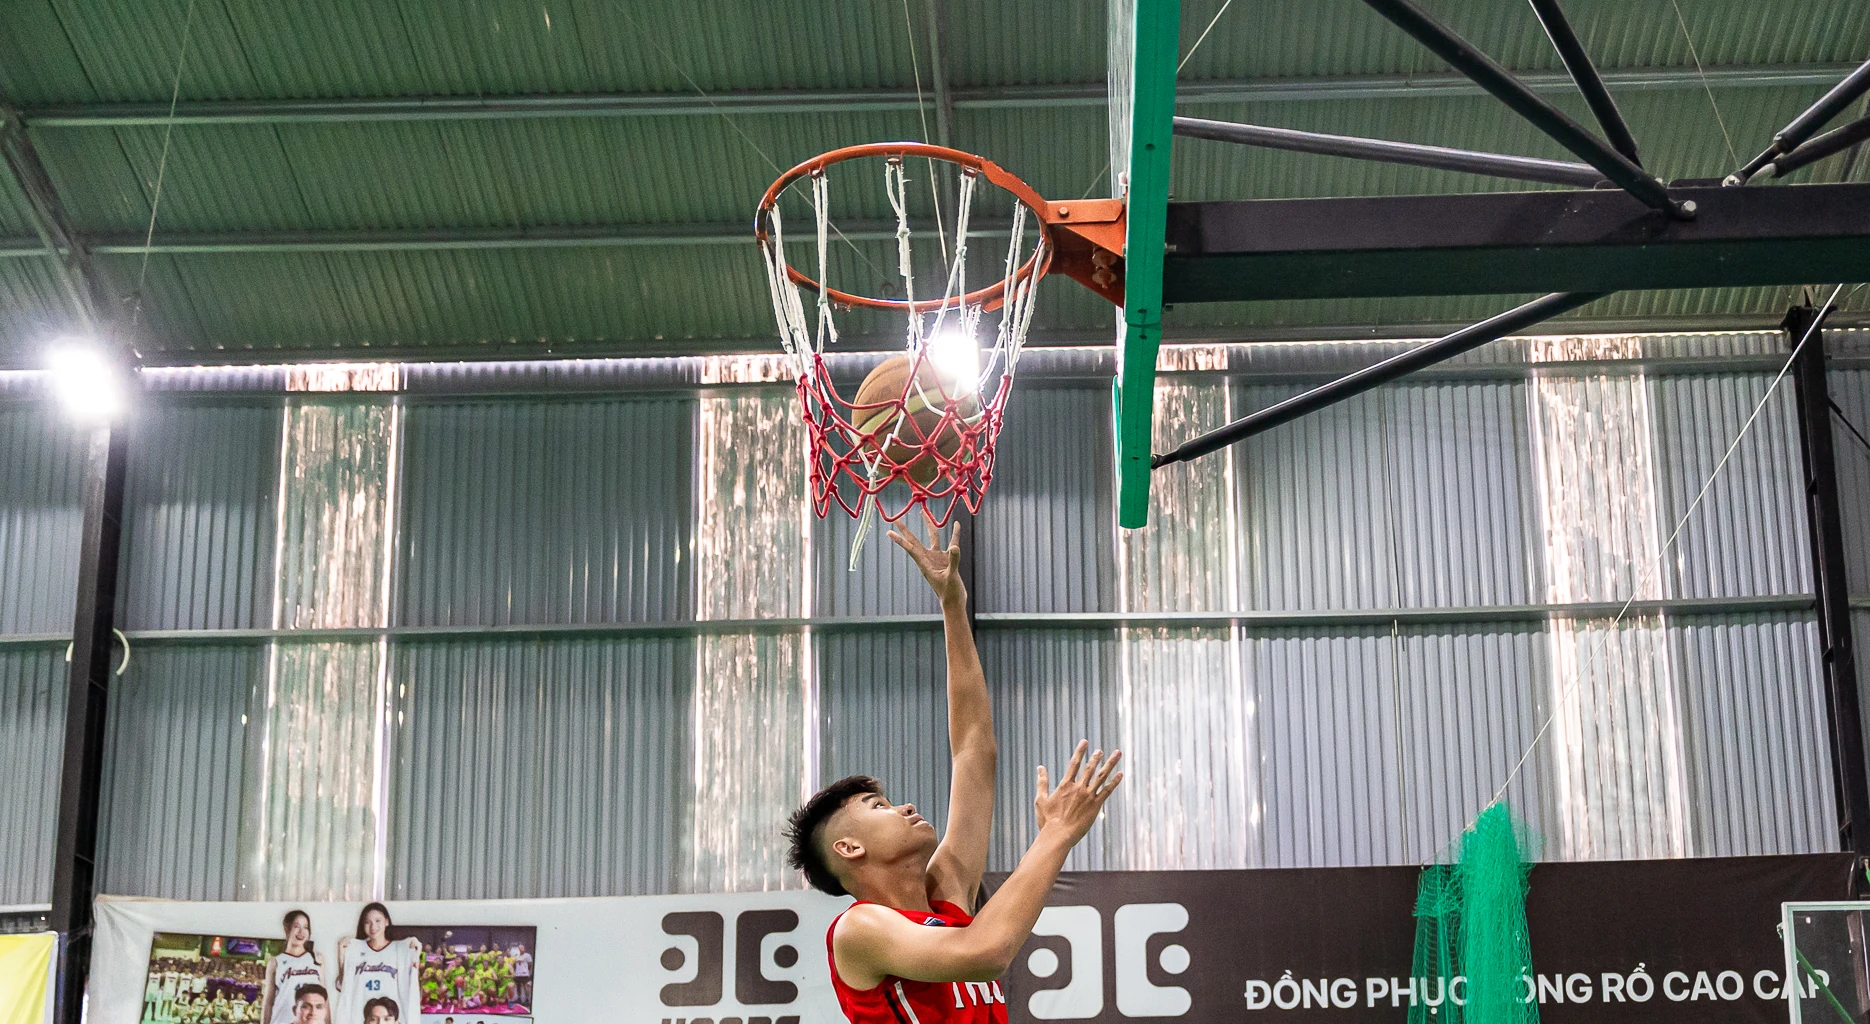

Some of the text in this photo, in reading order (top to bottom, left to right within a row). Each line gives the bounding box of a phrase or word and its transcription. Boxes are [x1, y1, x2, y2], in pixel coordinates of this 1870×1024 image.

[365, 979, 381, 991] 43
[1244, 969, 1358, 1010] ĐỒNG
[1366, 976, 1467, 1014] PHỤC
[1514, 966, 1592, 1004] ÓNG
[1602, 962, 1655, 1003] RỔ
[1663, 970, 1744, 1001] CAO
